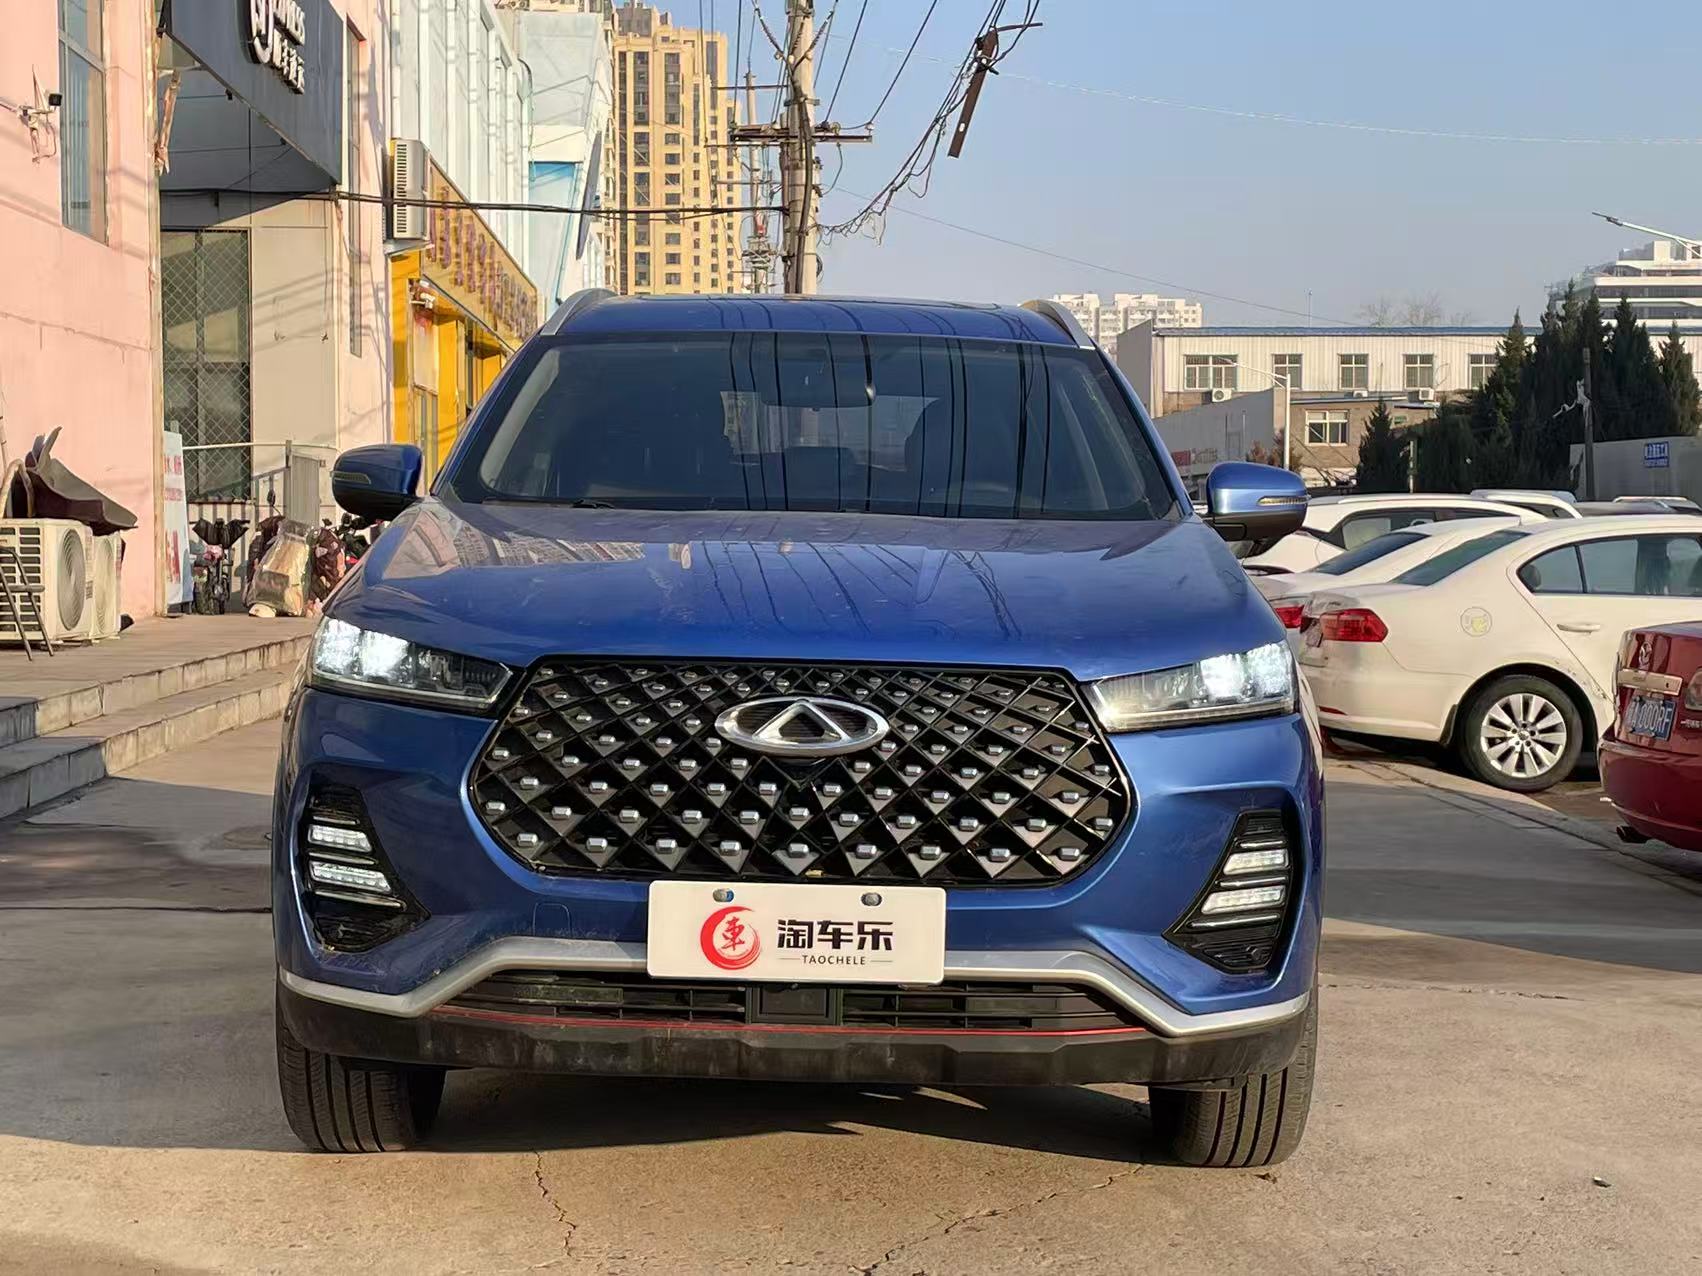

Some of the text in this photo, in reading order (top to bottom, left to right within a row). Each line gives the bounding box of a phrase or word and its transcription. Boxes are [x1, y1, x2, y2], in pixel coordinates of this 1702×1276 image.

[777, 919, 894, 951] 淘车乐
[802, 955, 866, 966] TAOCHELE
